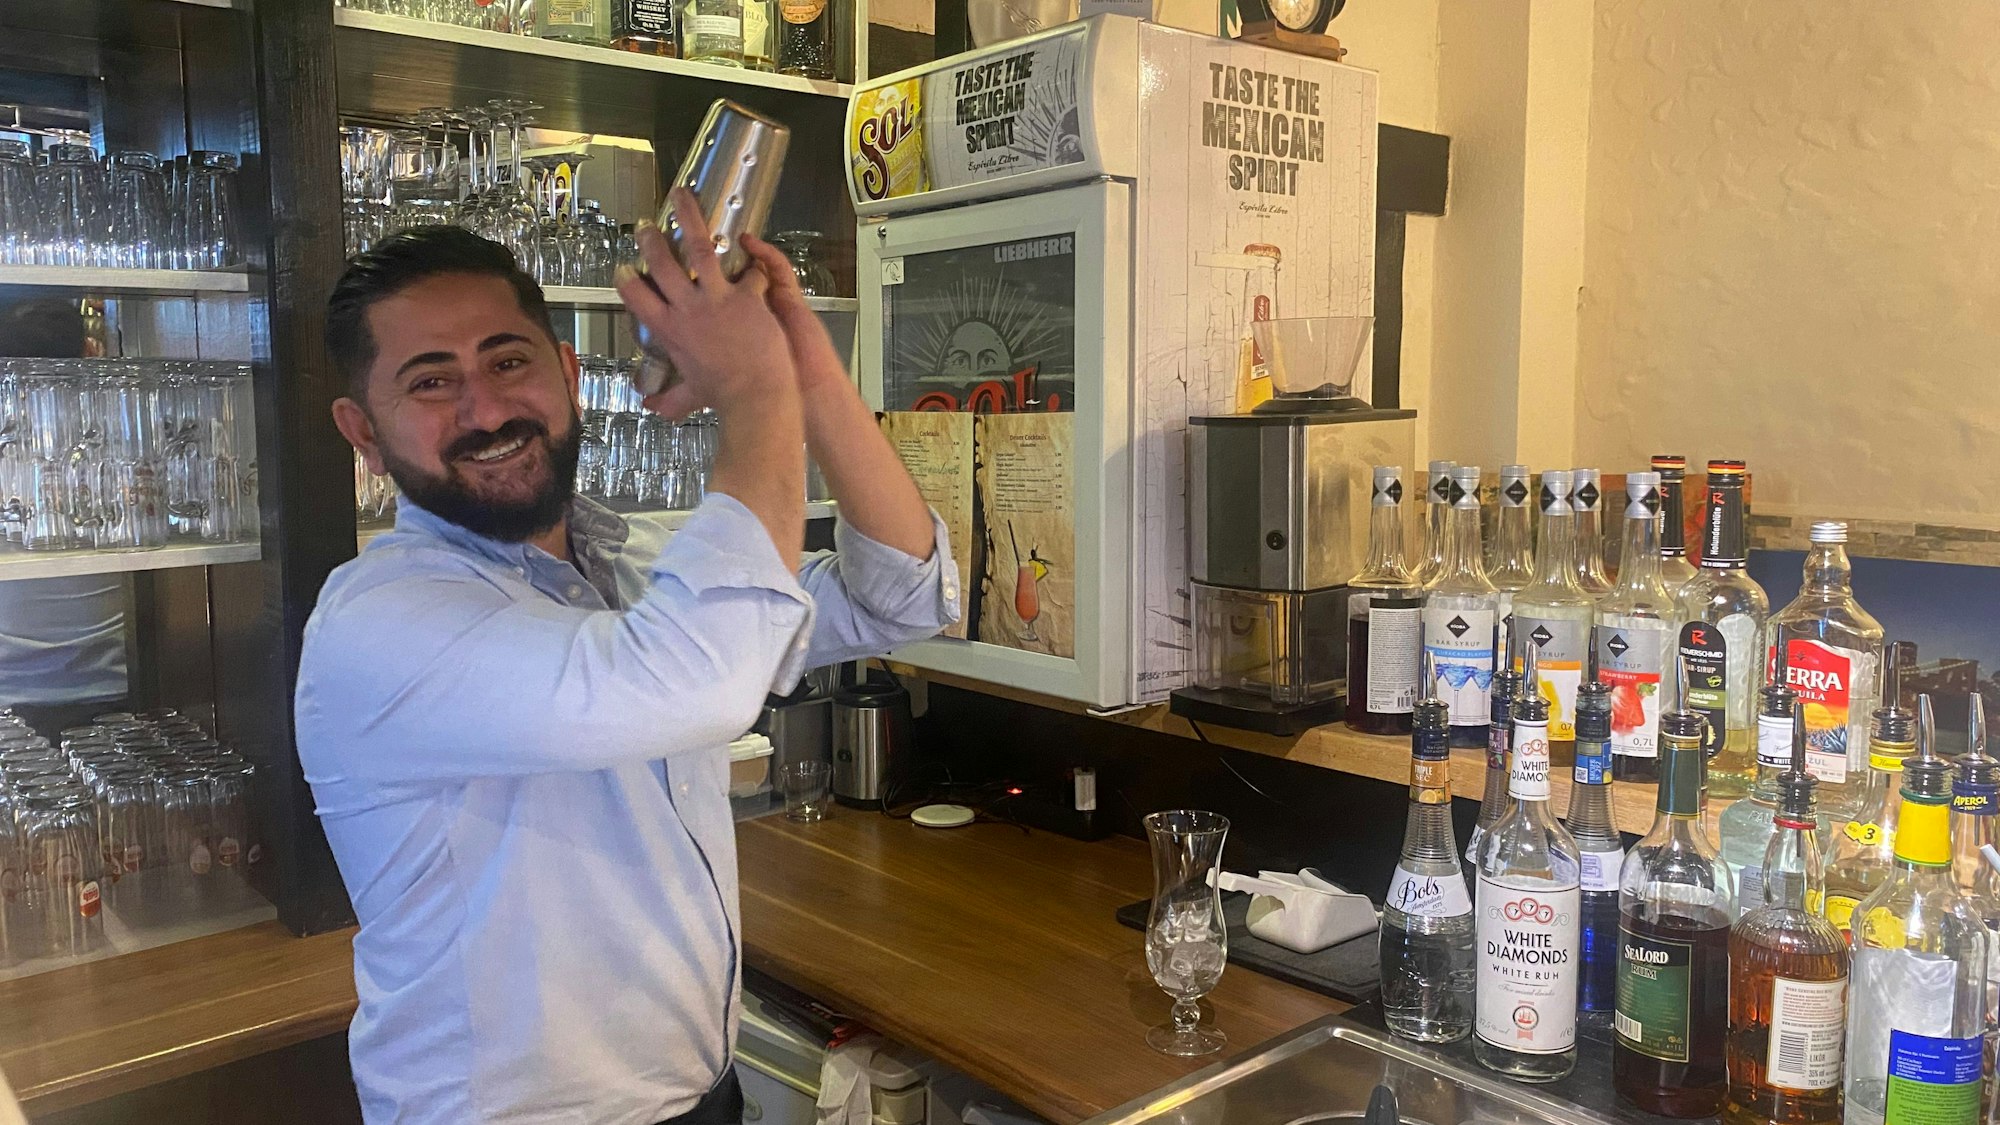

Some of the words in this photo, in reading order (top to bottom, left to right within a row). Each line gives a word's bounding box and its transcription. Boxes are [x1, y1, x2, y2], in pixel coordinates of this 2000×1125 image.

[636, 4, 667, 12] WHISKEY
[955, 60, 1003, 97] TASTE
[1004, 51, 1035, 84] THE
[1209, 62, 1279, 109] TASTE
[1283, 76, 1320, 116] THE
[956, 82, 1026, 126] MEXICAN
[965, 116, 1015, 154] SPIRIT
[1202, 101, 1325, 163] MEXICAN
[1229, 154, 1300, 196] SPIRIT
[994, 236, 1072, 263] LIEBHERR
[1710, 507, 1722, 556] Holunderblüte
[1798, 690, 1826, 701] UILA
[1414, 764, 1433, 776] TRIPLE
[1521, 760, 1548, 771] WHITE
[1808, 757, 1828, 767] ZUL
[1415, 774, 1431, 782] SEC
[1954, 795, 1989, 806] APEROL
[1864, 827, 1876, 840] 3
[1396, 876, 1439, 909] Bols
[1504, 929, 1552, 948] WHITE
[1487, 940, 1568, 965] DIAMONDS
[1492, 963, 1529, 979] WHITE
[1535, 971, 1559, 980] RUM
[1632, 965, 1656, 980] RUM
